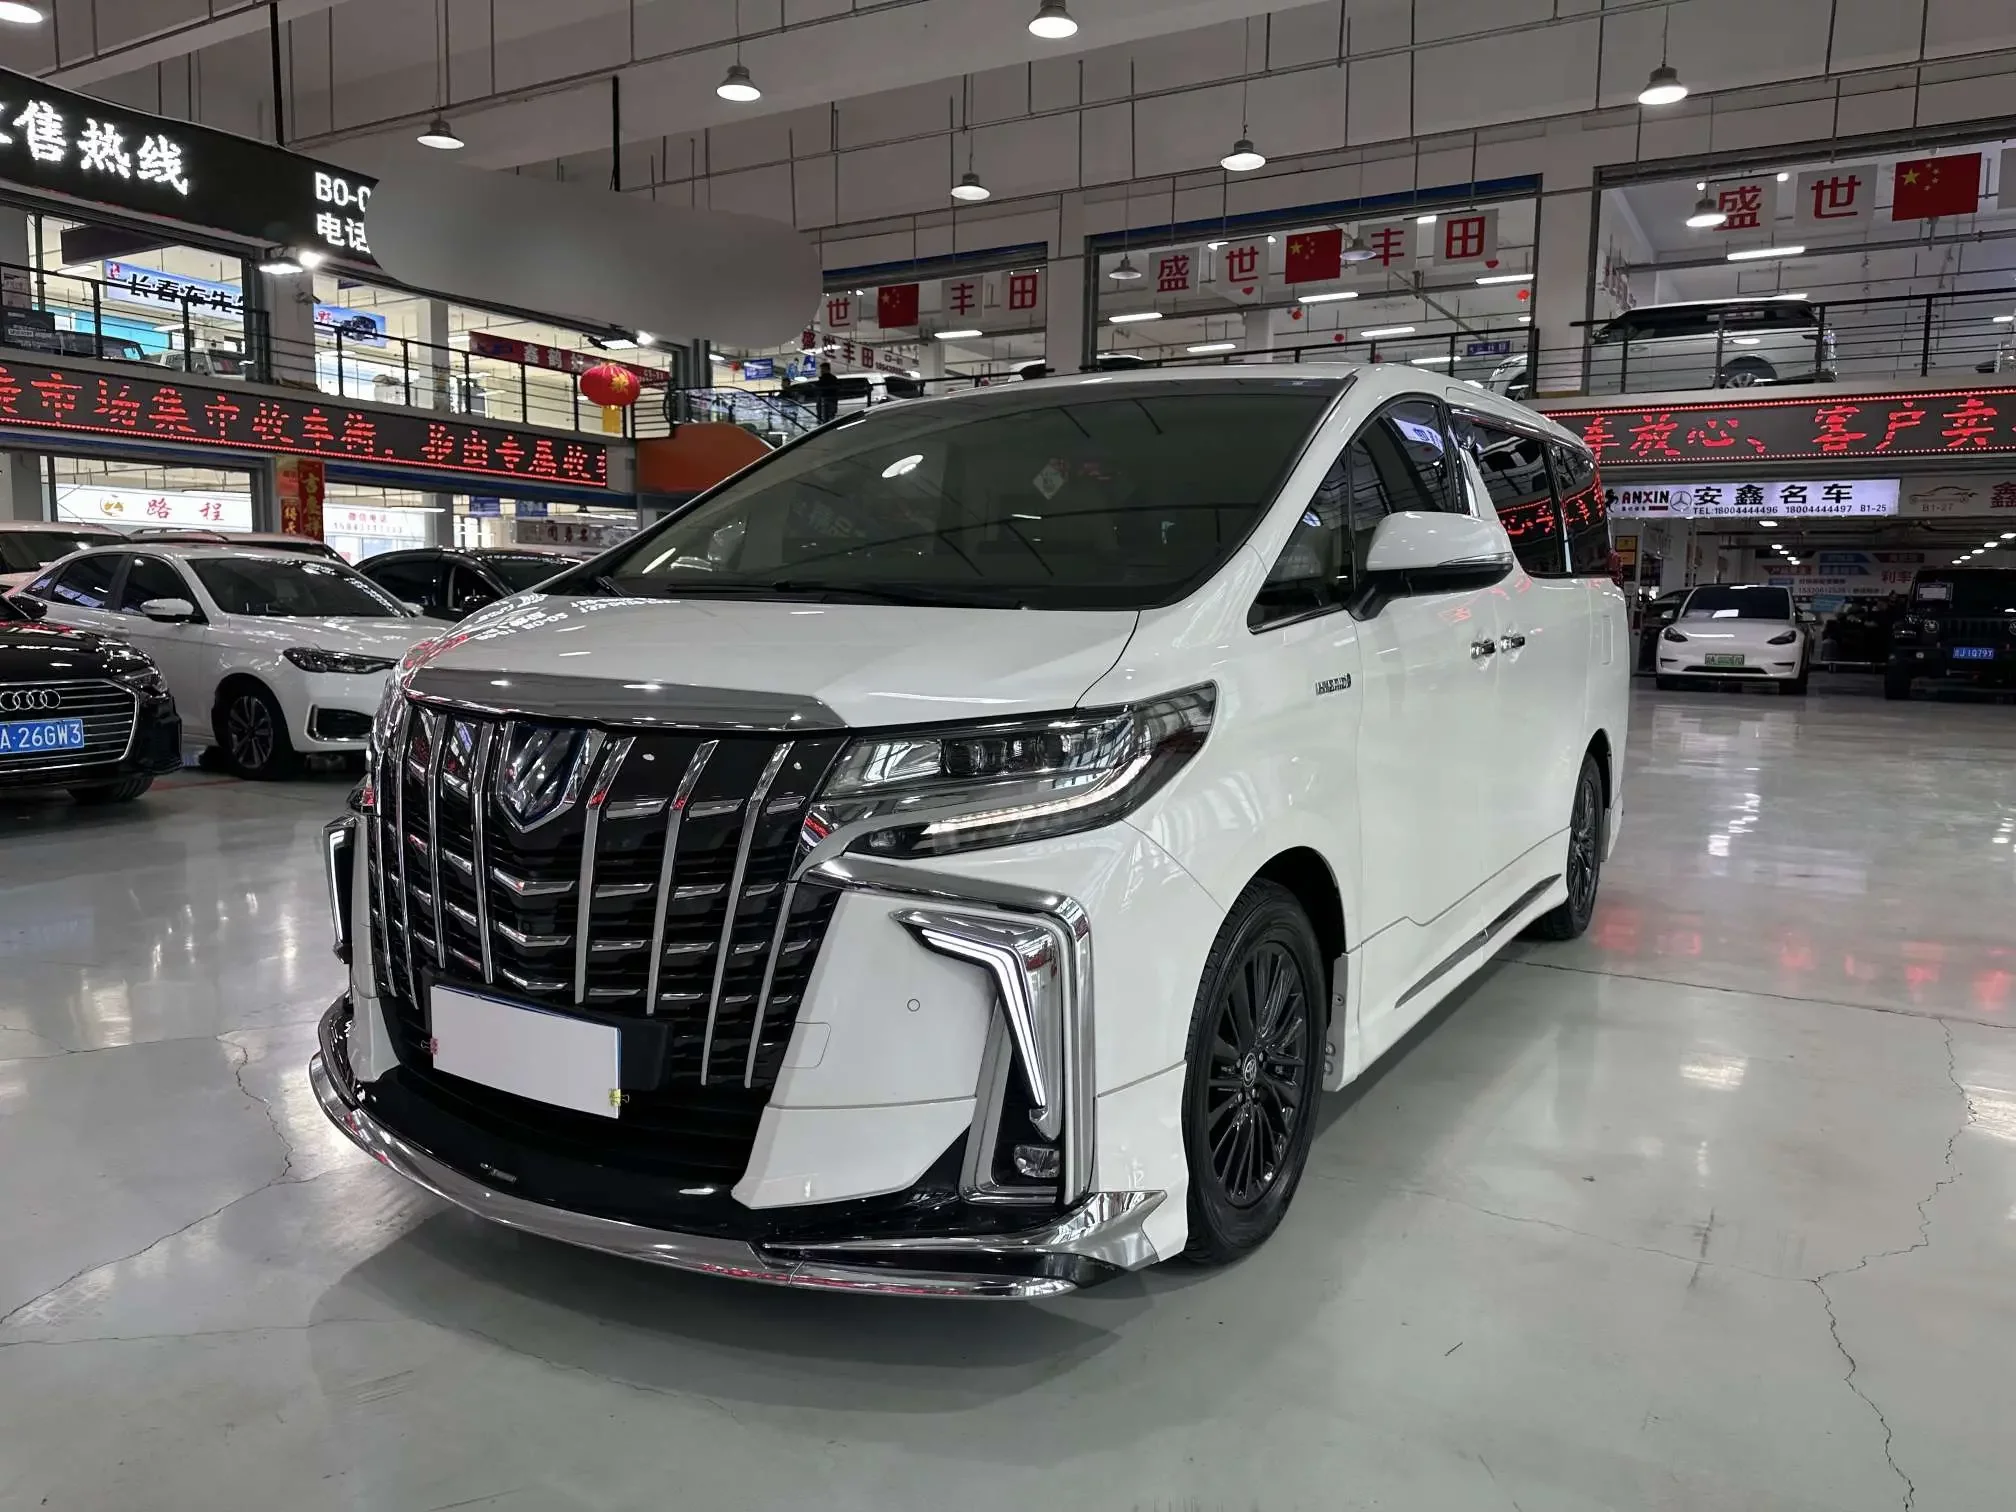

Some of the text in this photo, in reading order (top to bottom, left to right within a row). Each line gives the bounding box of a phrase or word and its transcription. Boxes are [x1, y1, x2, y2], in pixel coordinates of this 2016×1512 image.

[0, 100, 189, 195] 售热线
[1713, 175, 1862, 232] 盛 世
[1157, 216, 1486, 292] 盛 世 丰 田
[827, 274, 1037, 327] 世 丰 田
[1621, 490, 1669, 505] ANXIN
[1693, 483, 1852, 505] 安鑫名车
